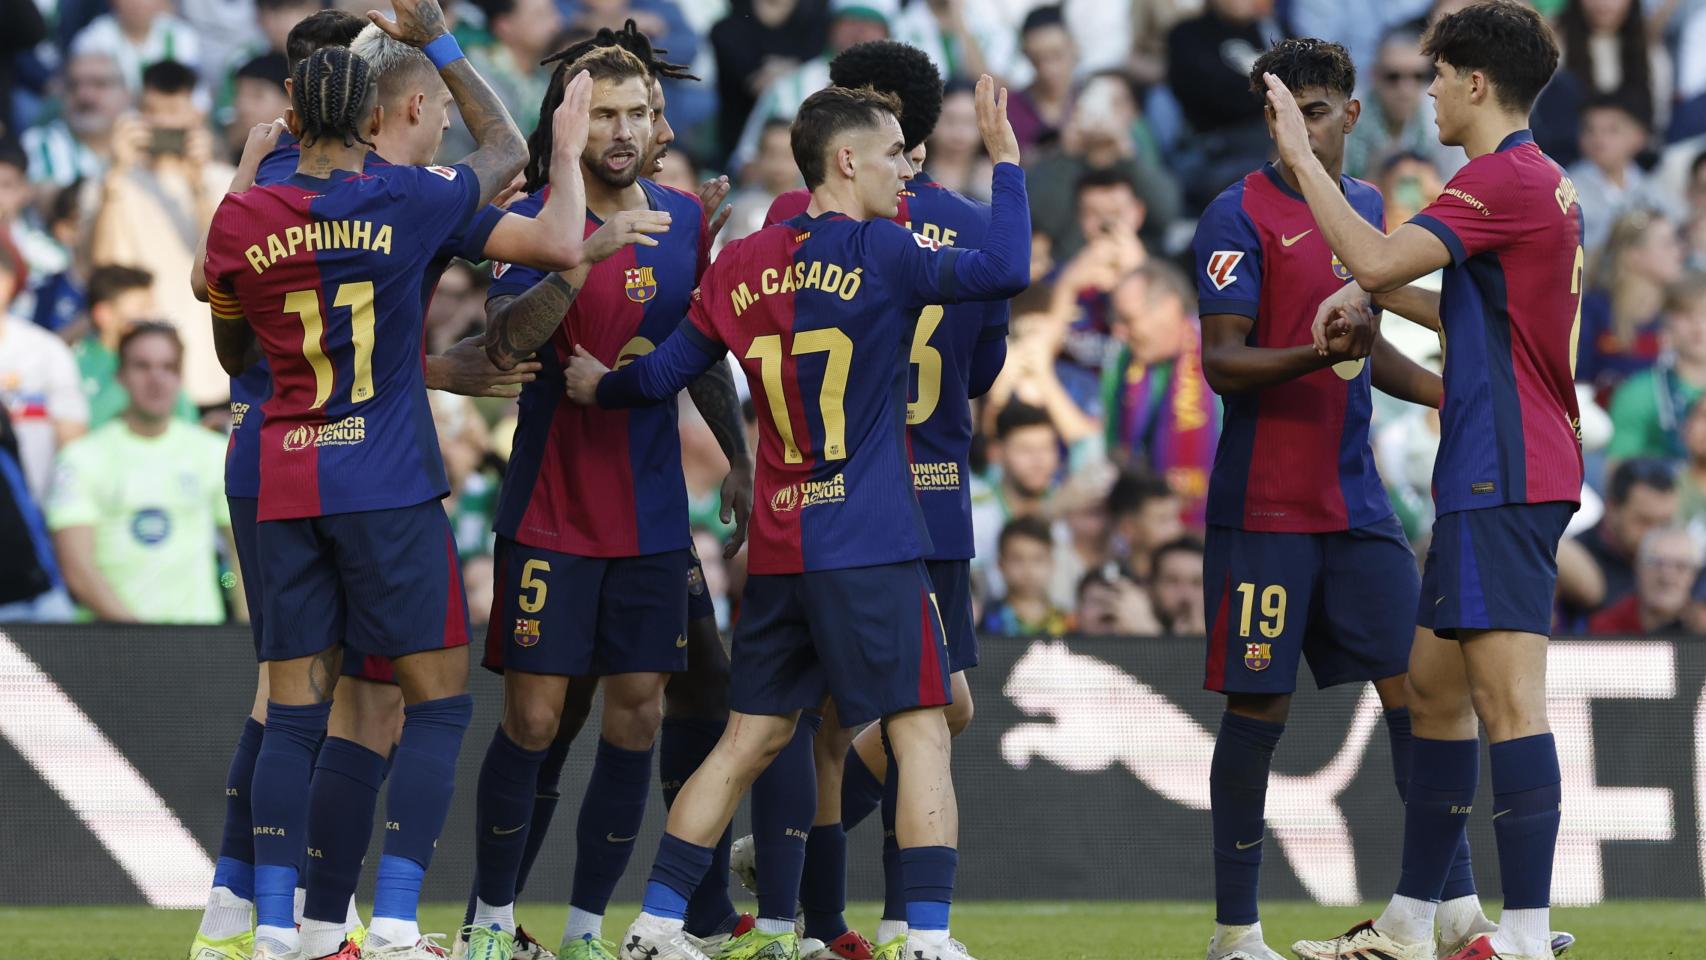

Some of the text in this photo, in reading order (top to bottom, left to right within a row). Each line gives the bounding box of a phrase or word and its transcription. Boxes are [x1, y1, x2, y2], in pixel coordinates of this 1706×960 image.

[245, 220, 393, 275] RAPHINHA
[730, 283, 760, 317] M.
[761, 261, 864, 301] CASADÓ
[283, 280, 376, 410] 11
[744, 327, 854, 464] 17
[314, 428, 365, 443] ACNUR
[910, 462, 958, 475] UNHCR
[913, 473, 960, 486] ACNUR
[518, 558, 551, 614] 5
[1236, 582, 1287, 638] 19
